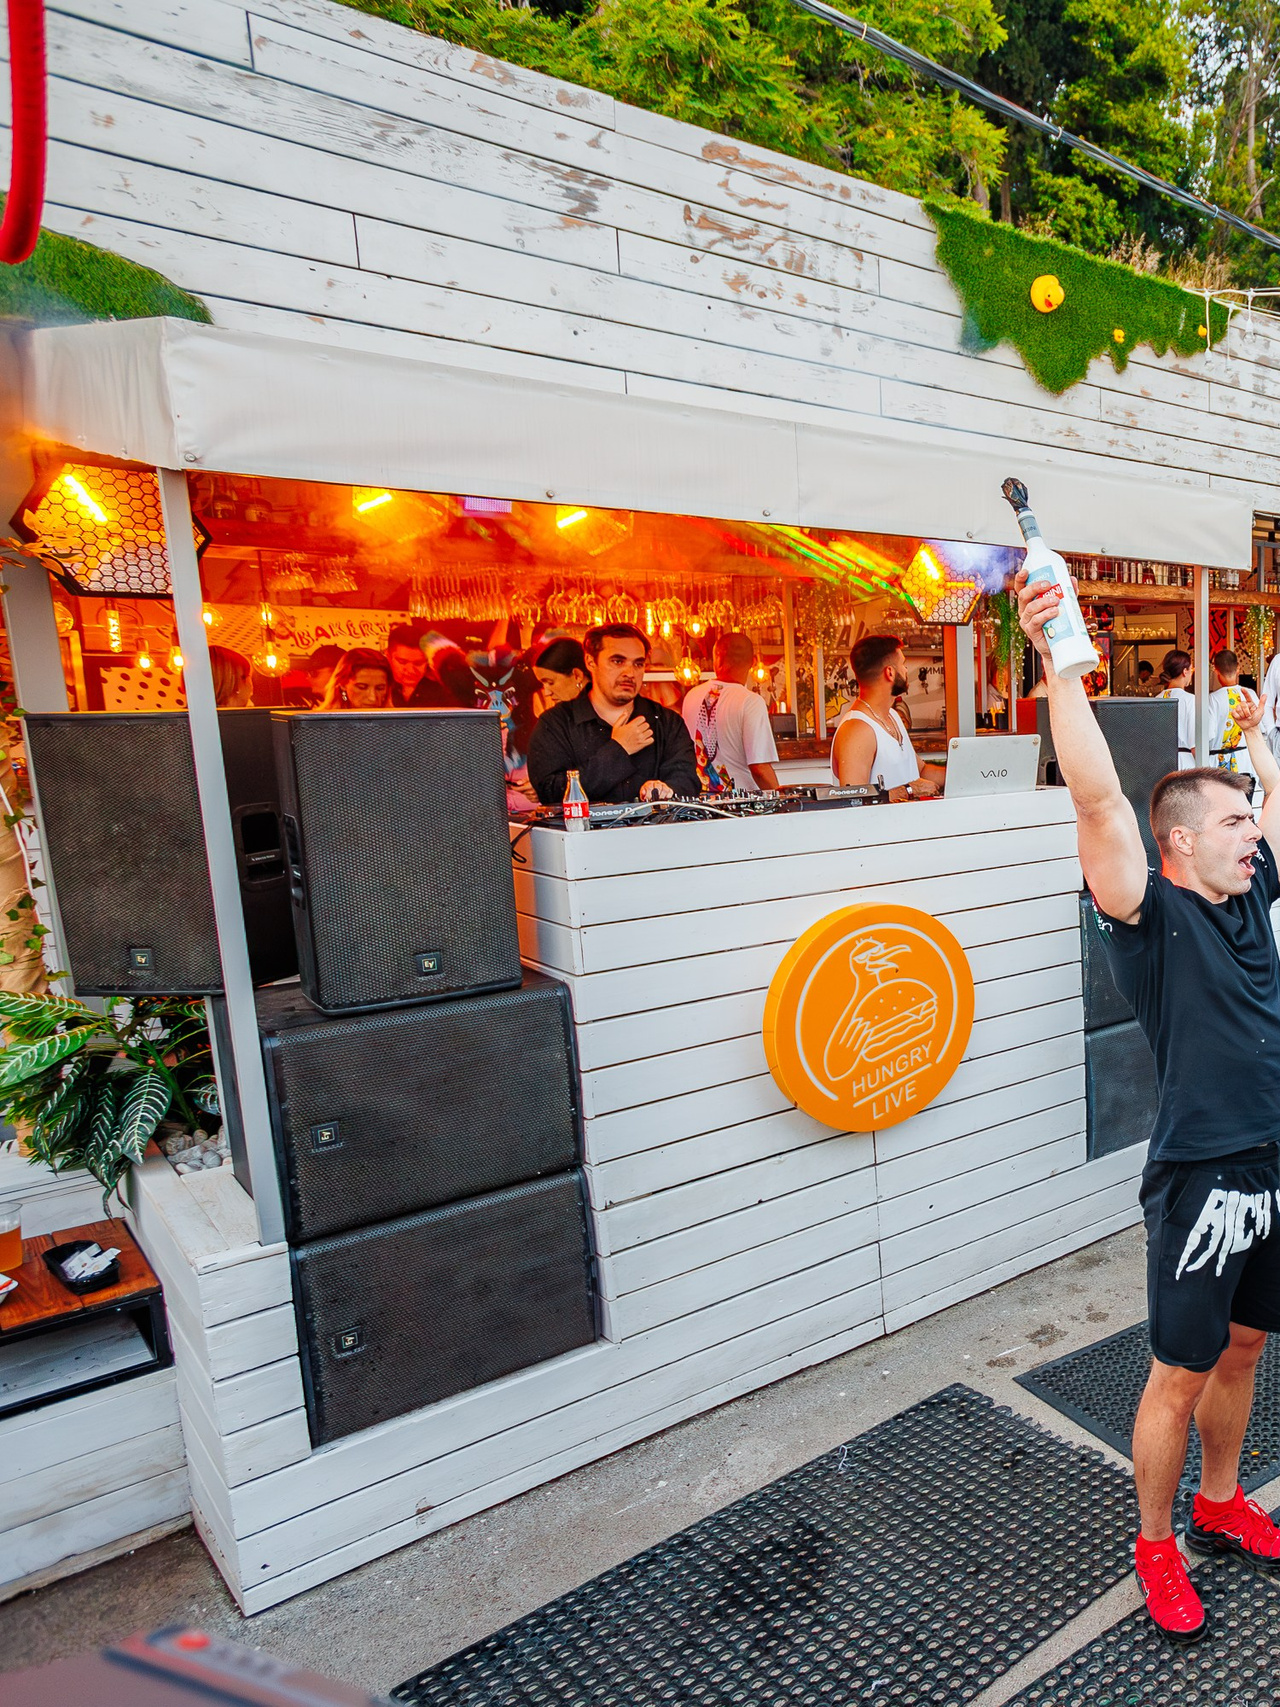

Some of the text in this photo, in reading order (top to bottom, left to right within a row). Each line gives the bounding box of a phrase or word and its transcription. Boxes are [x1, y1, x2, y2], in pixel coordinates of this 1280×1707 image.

[980, 768, 1008, 779] VAIO
[829, 788, 859, 796] Pioneer
[852, 1040, 933, 1098] HUNGRY
[872, 1080, 918, 1120] LIVE
